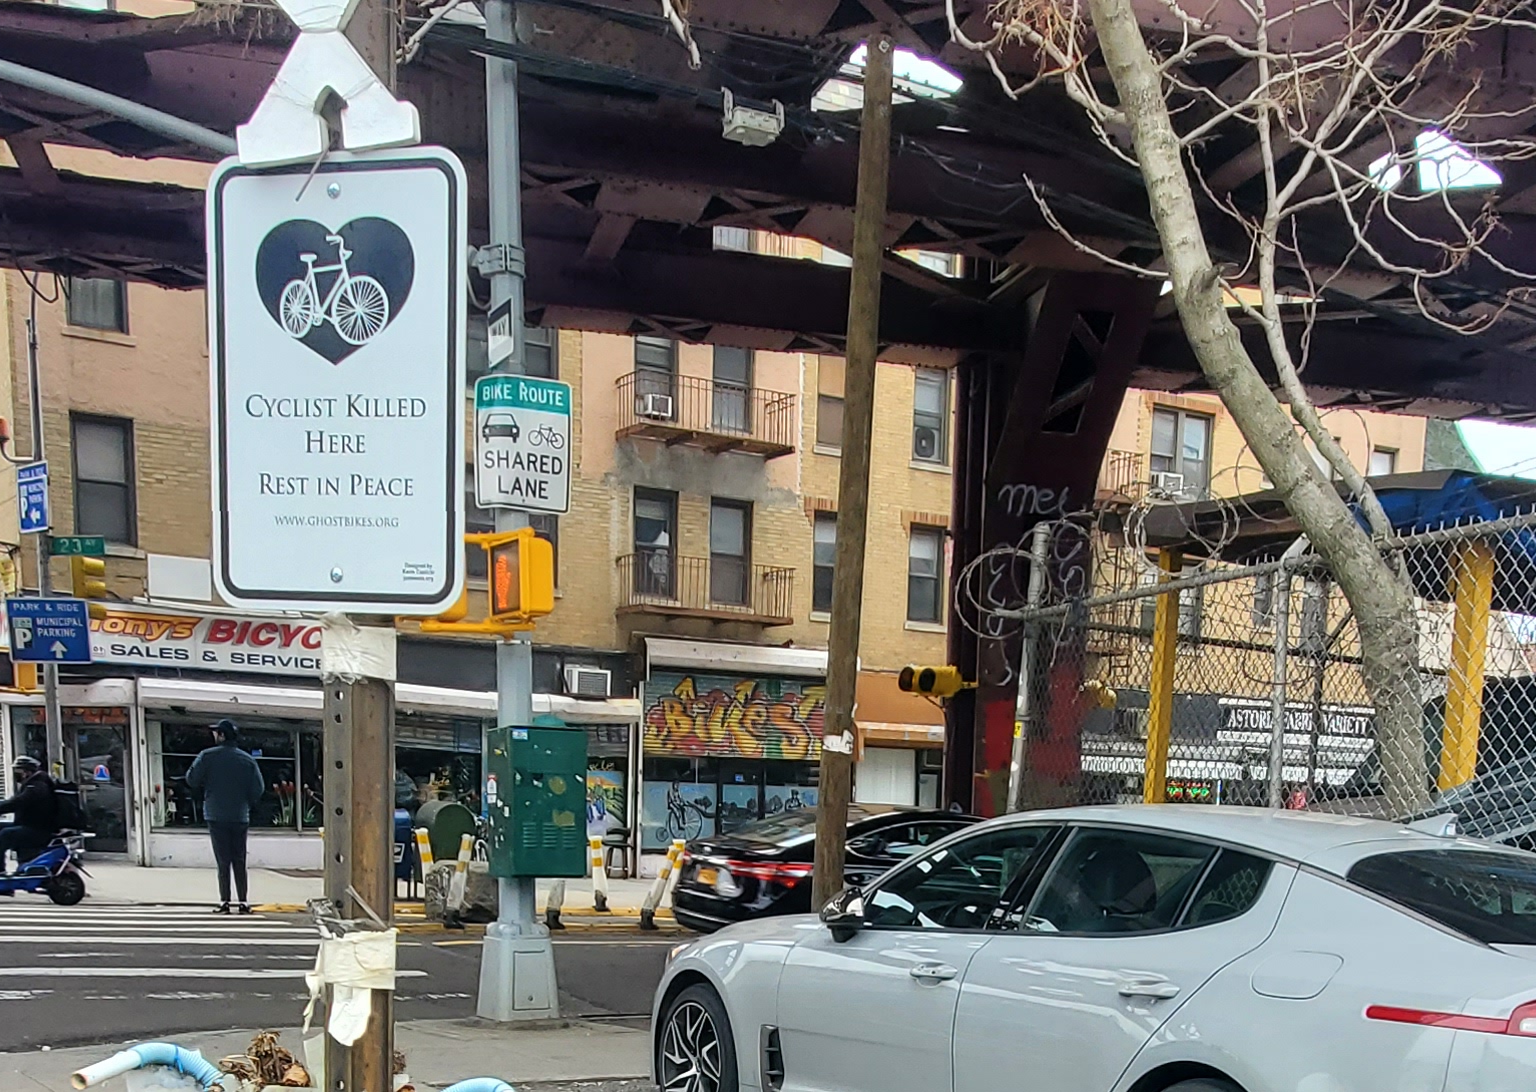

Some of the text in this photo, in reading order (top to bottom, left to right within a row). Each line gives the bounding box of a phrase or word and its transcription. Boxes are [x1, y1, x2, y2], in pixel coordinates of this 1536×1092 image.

[482, 383, 564, 406] BIKE ROUTE
[245, 394, 426, 417] CYCLIST KILLED
[305, 430, 366, 453] HERE
[484, 450, 563, 475] SHARED
[259, 472, 413, 496] REST IN PEACE
[498, 475, 548, 499] LANE
[274, 515, 399, 528] WWW.GHOSTBIKES.ORG
[60, 538, 82, 553] 23
[13, 602, 79, 612] PARK & RIDE
[36, 617, 83, 627] MUNICIPAL
[15, 628, 32, 649] P
[37, 628, 76, 638] PARKING
[111, 644, 189, 661] SALES
[202, 650, 218, 662] &
